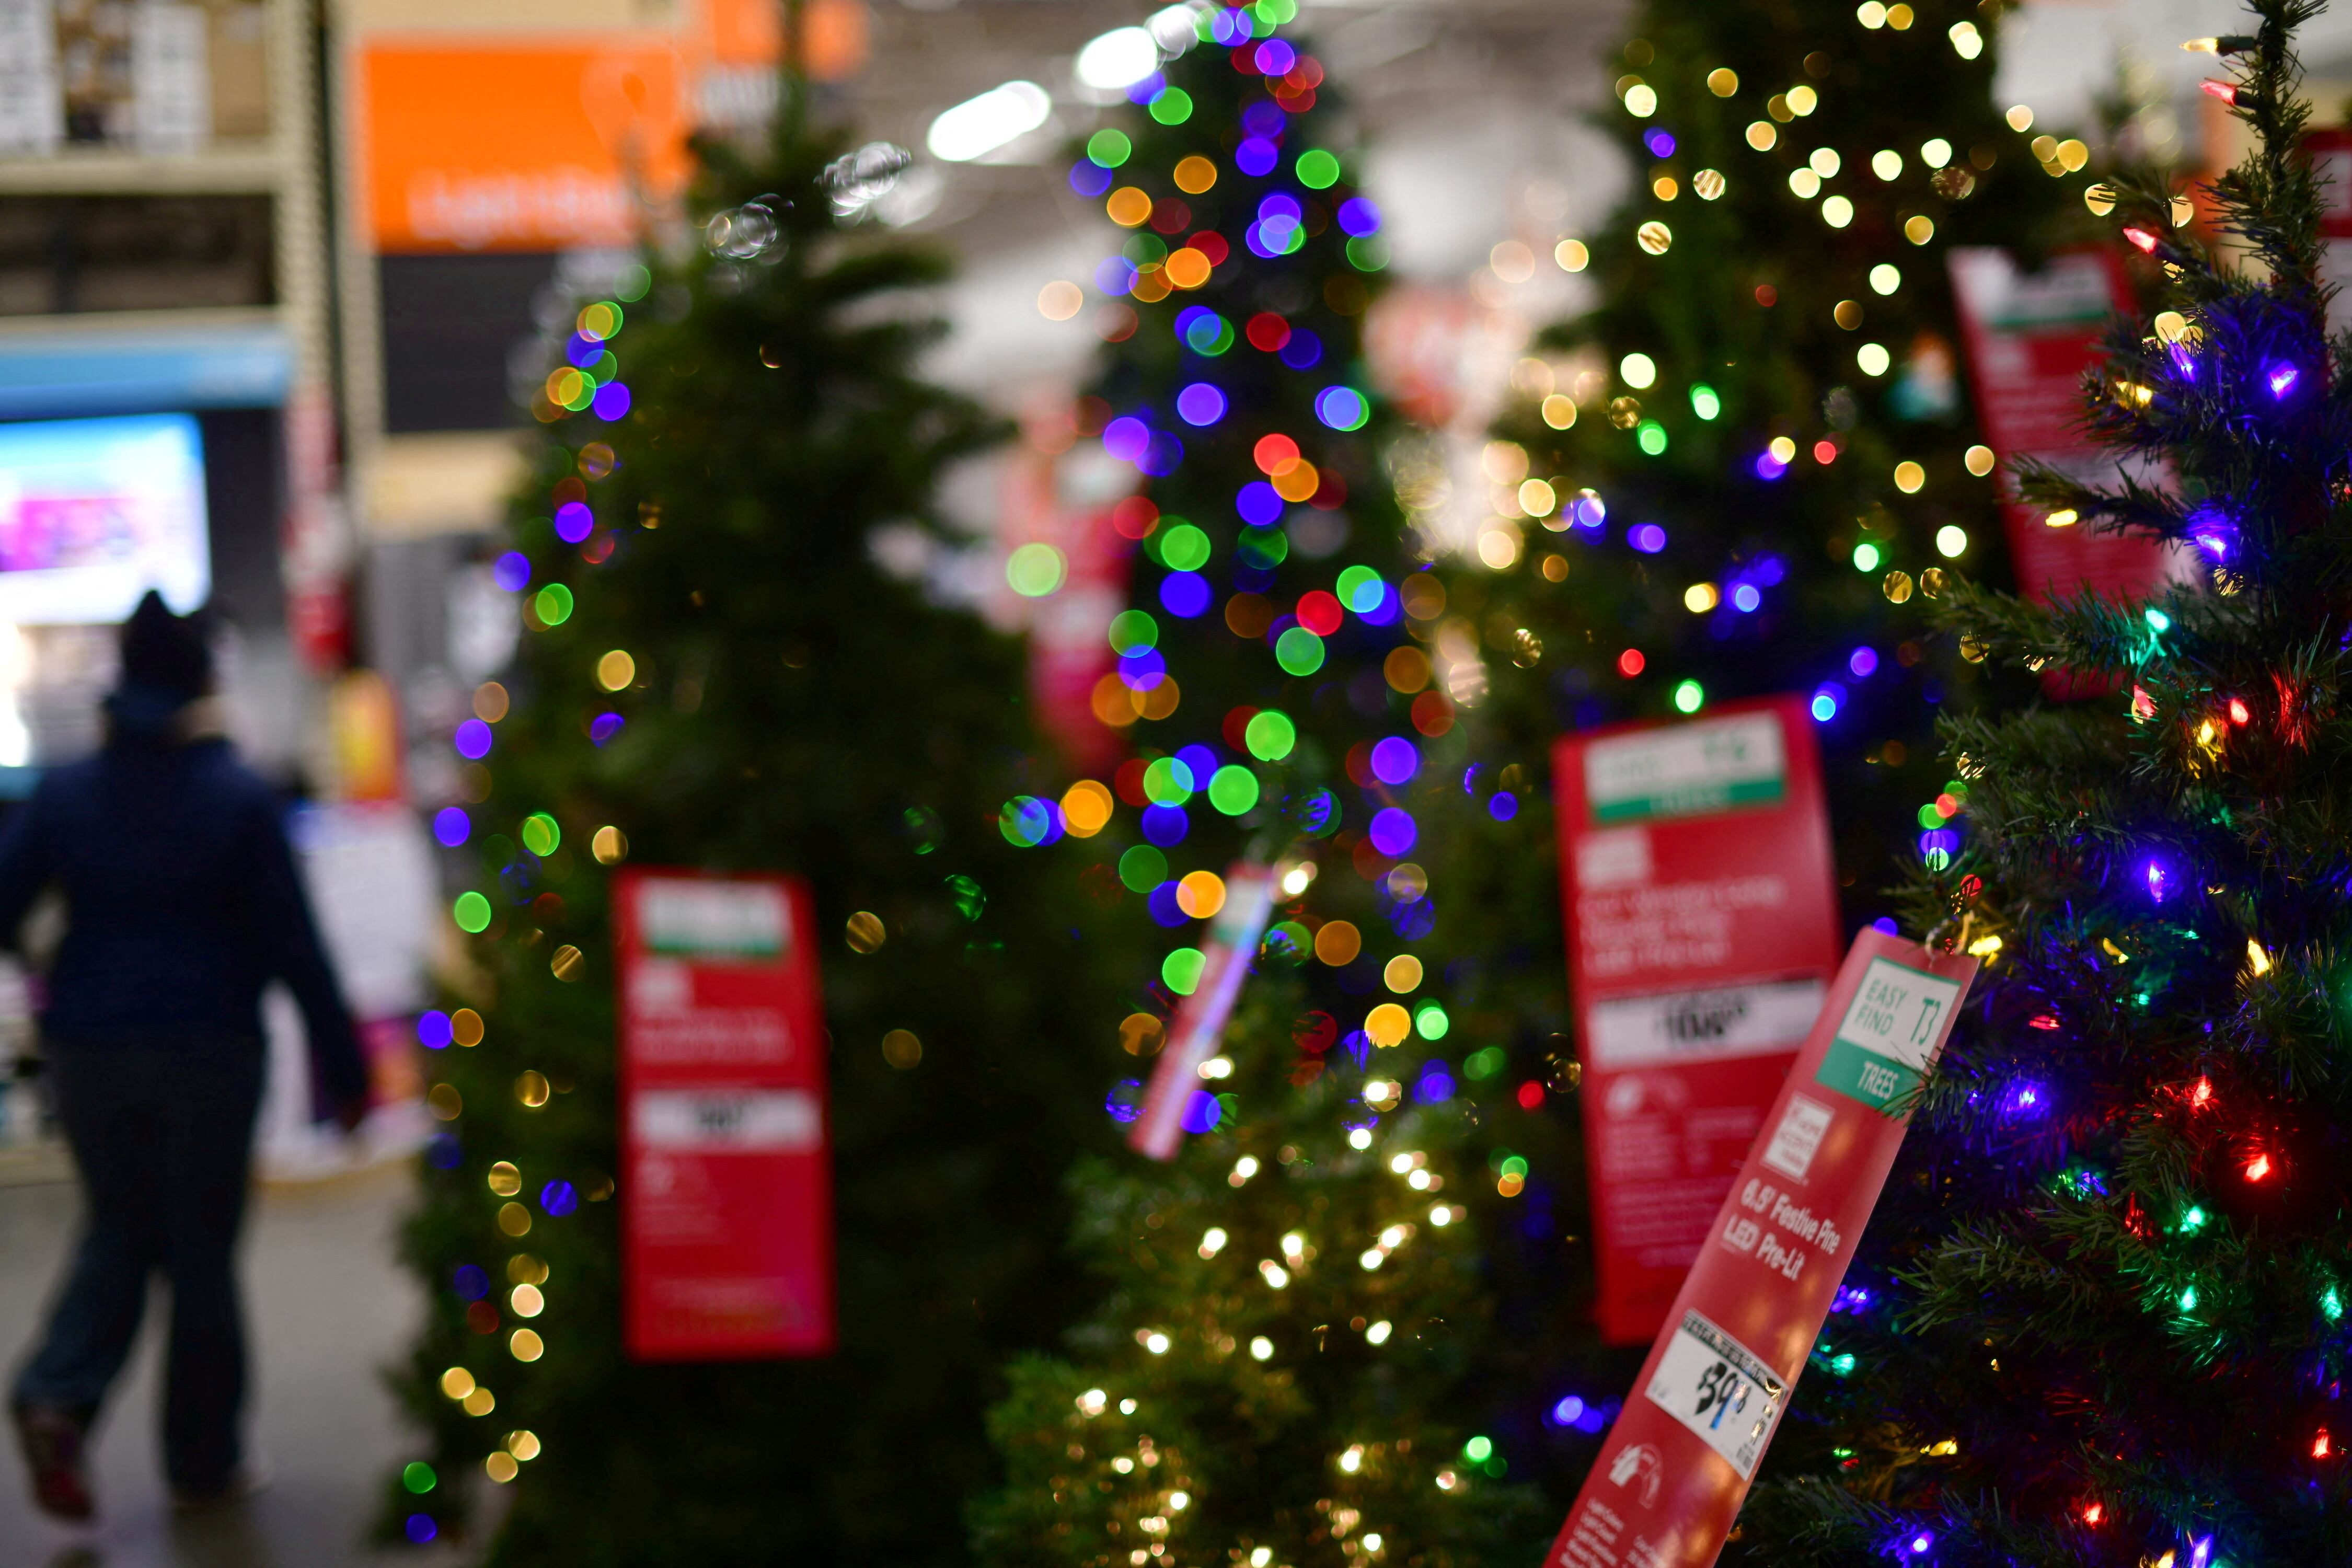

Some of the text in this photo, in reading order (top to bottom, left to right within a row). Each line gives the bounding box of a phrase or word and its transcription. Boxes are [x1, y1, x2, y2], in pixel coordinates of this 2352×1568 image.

[1864, 979, 1909, 1011] EASY
[1854, 1004, 1895, 1036] FIND
[1910, 996, 1941, 1046] T3
[1857, 1060, 1899, 1100] TREES
[1770, 1193, 1819, 1242] Festive
[1814, 1218, 1840, 1255] Pine
[1723, 1213, 1760, 1252] LED
[1756, 1232, 1806, 1281] Pre-Lit
